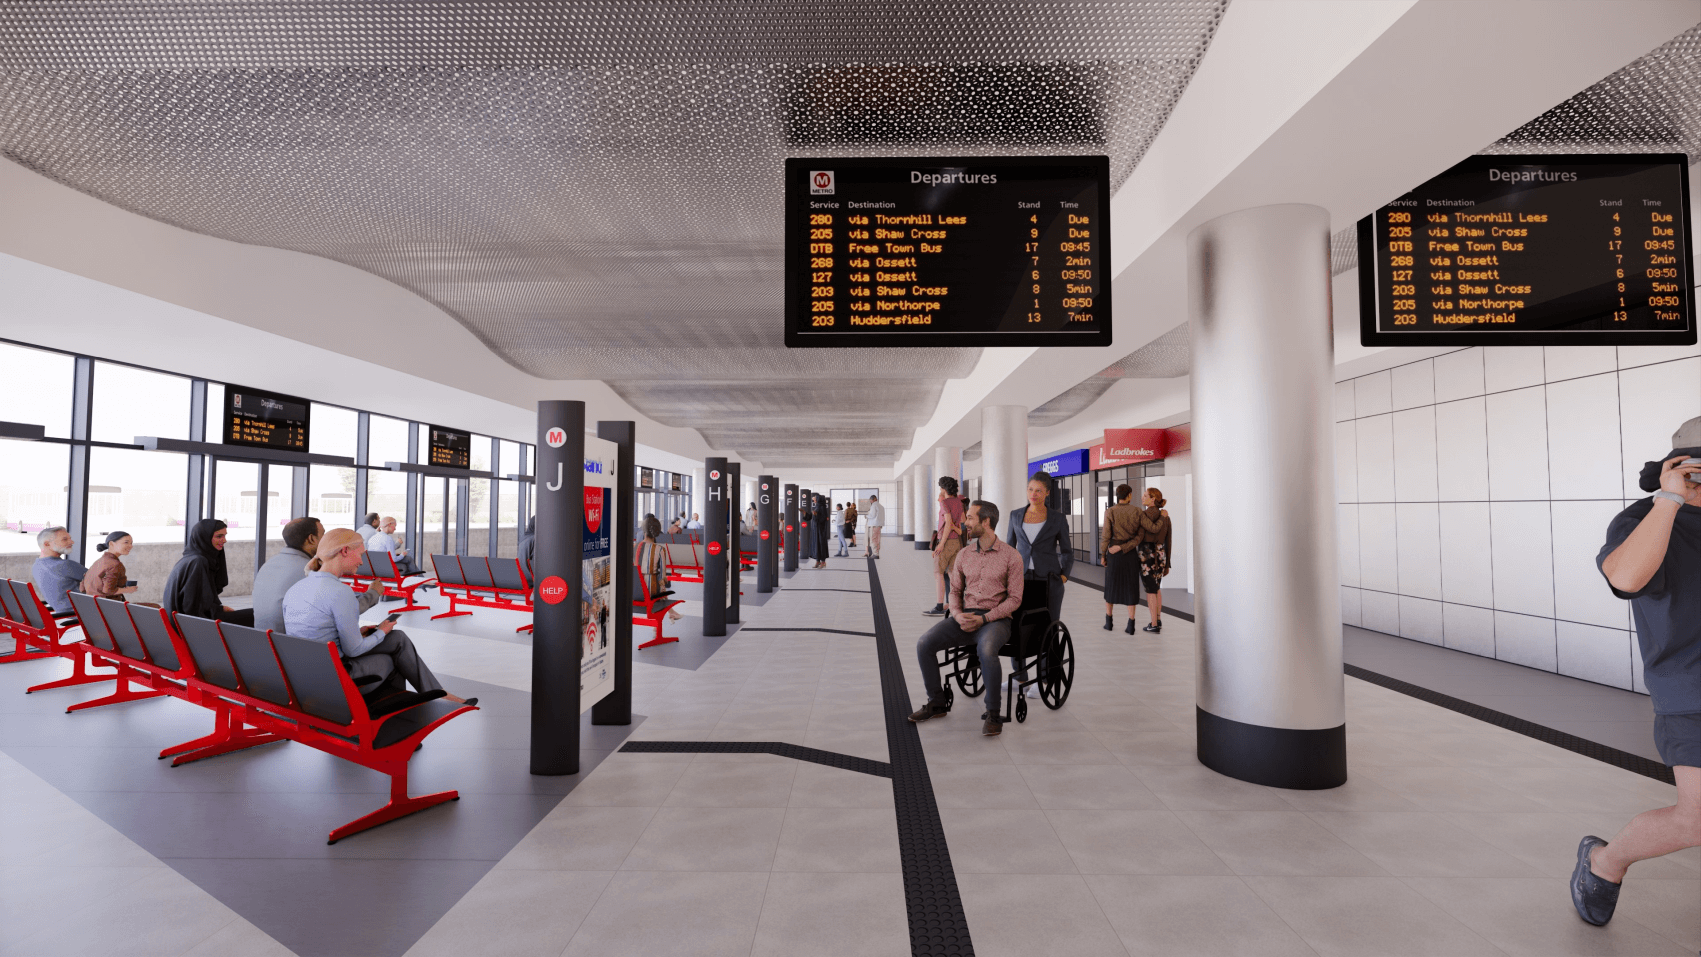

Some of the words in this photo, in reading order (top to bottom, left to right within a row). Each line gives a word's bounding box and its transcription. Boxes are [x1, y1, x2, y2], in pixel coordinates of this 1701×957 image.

[816, 175, 828, 186] M
[910, 171, 997, 187] Departures
[1489, 169, 1578, 184] Departures
[810, 214, 832, 226] 280
[848, 214, 868, 224] via
[876, 214, 932, 224] Thornhill
[938, 214, 966, 224] Lees
[1030, 214, 1038, 224] 4
[1068, 214, 1090, 224] Due
[1388, 212, 1410, 222] 280
[1428, 212, 1448, 222] via
[1454, 212, 1512, 222] Thornhill
[1520, 212, 1548, 222] Lees
[1612, 212, 1620, 222] 4
[1652, 212, 1672, 222] Due
[810, 228, 832, 240] 205
[848, 228, 870, 240] via
[874, 228, 904, 240] Shaw
[910, 228, 946, 238] Cross
[1030, 228, 1038, 238] 9
[1068, 228, 1090, 238] Due
[1388, 226, 1412, 238] 205
[1428, 226, 1448, 238] via
[1454, 226, 1484, 236] Shaw
[1492, 226, 1528, 236] Cross
[1614, 226, 1622, 236] 9
[1652, 226, 1674, 236] Due
[810, 242, 834, 254] DTB
[848, 242, 880, 254] Free
[886, 242, 914, 254] Town
[920, 242, 942, 252] Bus
[1026, 242, 1038, 252] 17
[1060, 242, 1090, 252] 09:45
[1390, 240, 1414, 252] DTB
[1428, 240, 1460, 252] Free
[1466, 240, 1496, 252] Town
[1502, 240, 1524, 252] Bus
[1608, 240, 1622, 250] 17
[1644, 240, 1674, 250] 09:45
[810, 258, 834, 268] 268
[850, 258, 870, 268] via
[876, 258, 916, 268] Ossett
[1032, 256, 1038, 266] 7
[1066, 256, 1090, 266] 2min
[1390, 256, 1414, 266] 268
[1430, 256, 1450, 266] via
[1456, 256, 1498, 266] Ossett
[1616, 254, 1622, 264] 7
[1650, 254, 1676, 264] 2min
[812, 272, 832, 282] 127
[850, 272, 870, 282] via
[876, 272, 918, 282] Ossett
[1032, 270, 1040, 280] 6
[1062, 270, 1092, 280] 09:50
[1392, 270, 1412, 282] 127
[1430, 270, 1452, 280] via
[1458, 270, 1500, 280] Ossett
[1616, 268, 1624, 278] 6
[1646, 268, 1676, 278] 09:50
[812, 286, 834, 298] 203
[850, 286, 870, 296] via
[876, 286, 906, 296] Shaw
[912, 286, 948, 296] Cross
[1032, 284, 1040, 294] 8
[1066, 284, 1092, 294] 5min
[1392, 284, 1416, 296] 203
[1432, 284, 1452, 294] via
[1458, 284, 1488, 294] Shaw
[1494, 284, 1532, 294] Cross
[1618, 282, 1624, 292] 8
[1652, 282, 1678, 292] 5min
[812, 300, 834, 312] 205
[850, 300, 870, 312] via
[876, 300, 940, 312] Northorpe
[1034, 298, 1040, 308] 1
[1062, 298, 1092, 308] 09:50
[1392, 300, 1416, 310] 205
[1432, 300, 1454, 310] via
[1458, 298, 1524, 310] Northorpe
[1620, 298, 1624, 306] 1
[1648, 296, 1678, 306] 09:50
[812, 316, 834, 326] 203
[850, 314, 932, 326] Huddersfield
[1028, 312, 1040, 322] 13
[1068, 312, 1092, 322] 7min
[1394, 314, 1416, 324] 203
[1432, 312, 1516, 324] Huddersfield
[1614, 312, 1628, 320] 13
[1654, 310, 1678, 320] 7min
[550, 432, 562, 443] M
[1110, 447, 1154, 456] Ladbrokes
[1043, 460, 1059, 473] GREGGS
[546, 462, 563, 492] J
[709, 486, 720, 501] H
[760, 494, 769, 504] G
[542, 587, 563, 595] HELP
